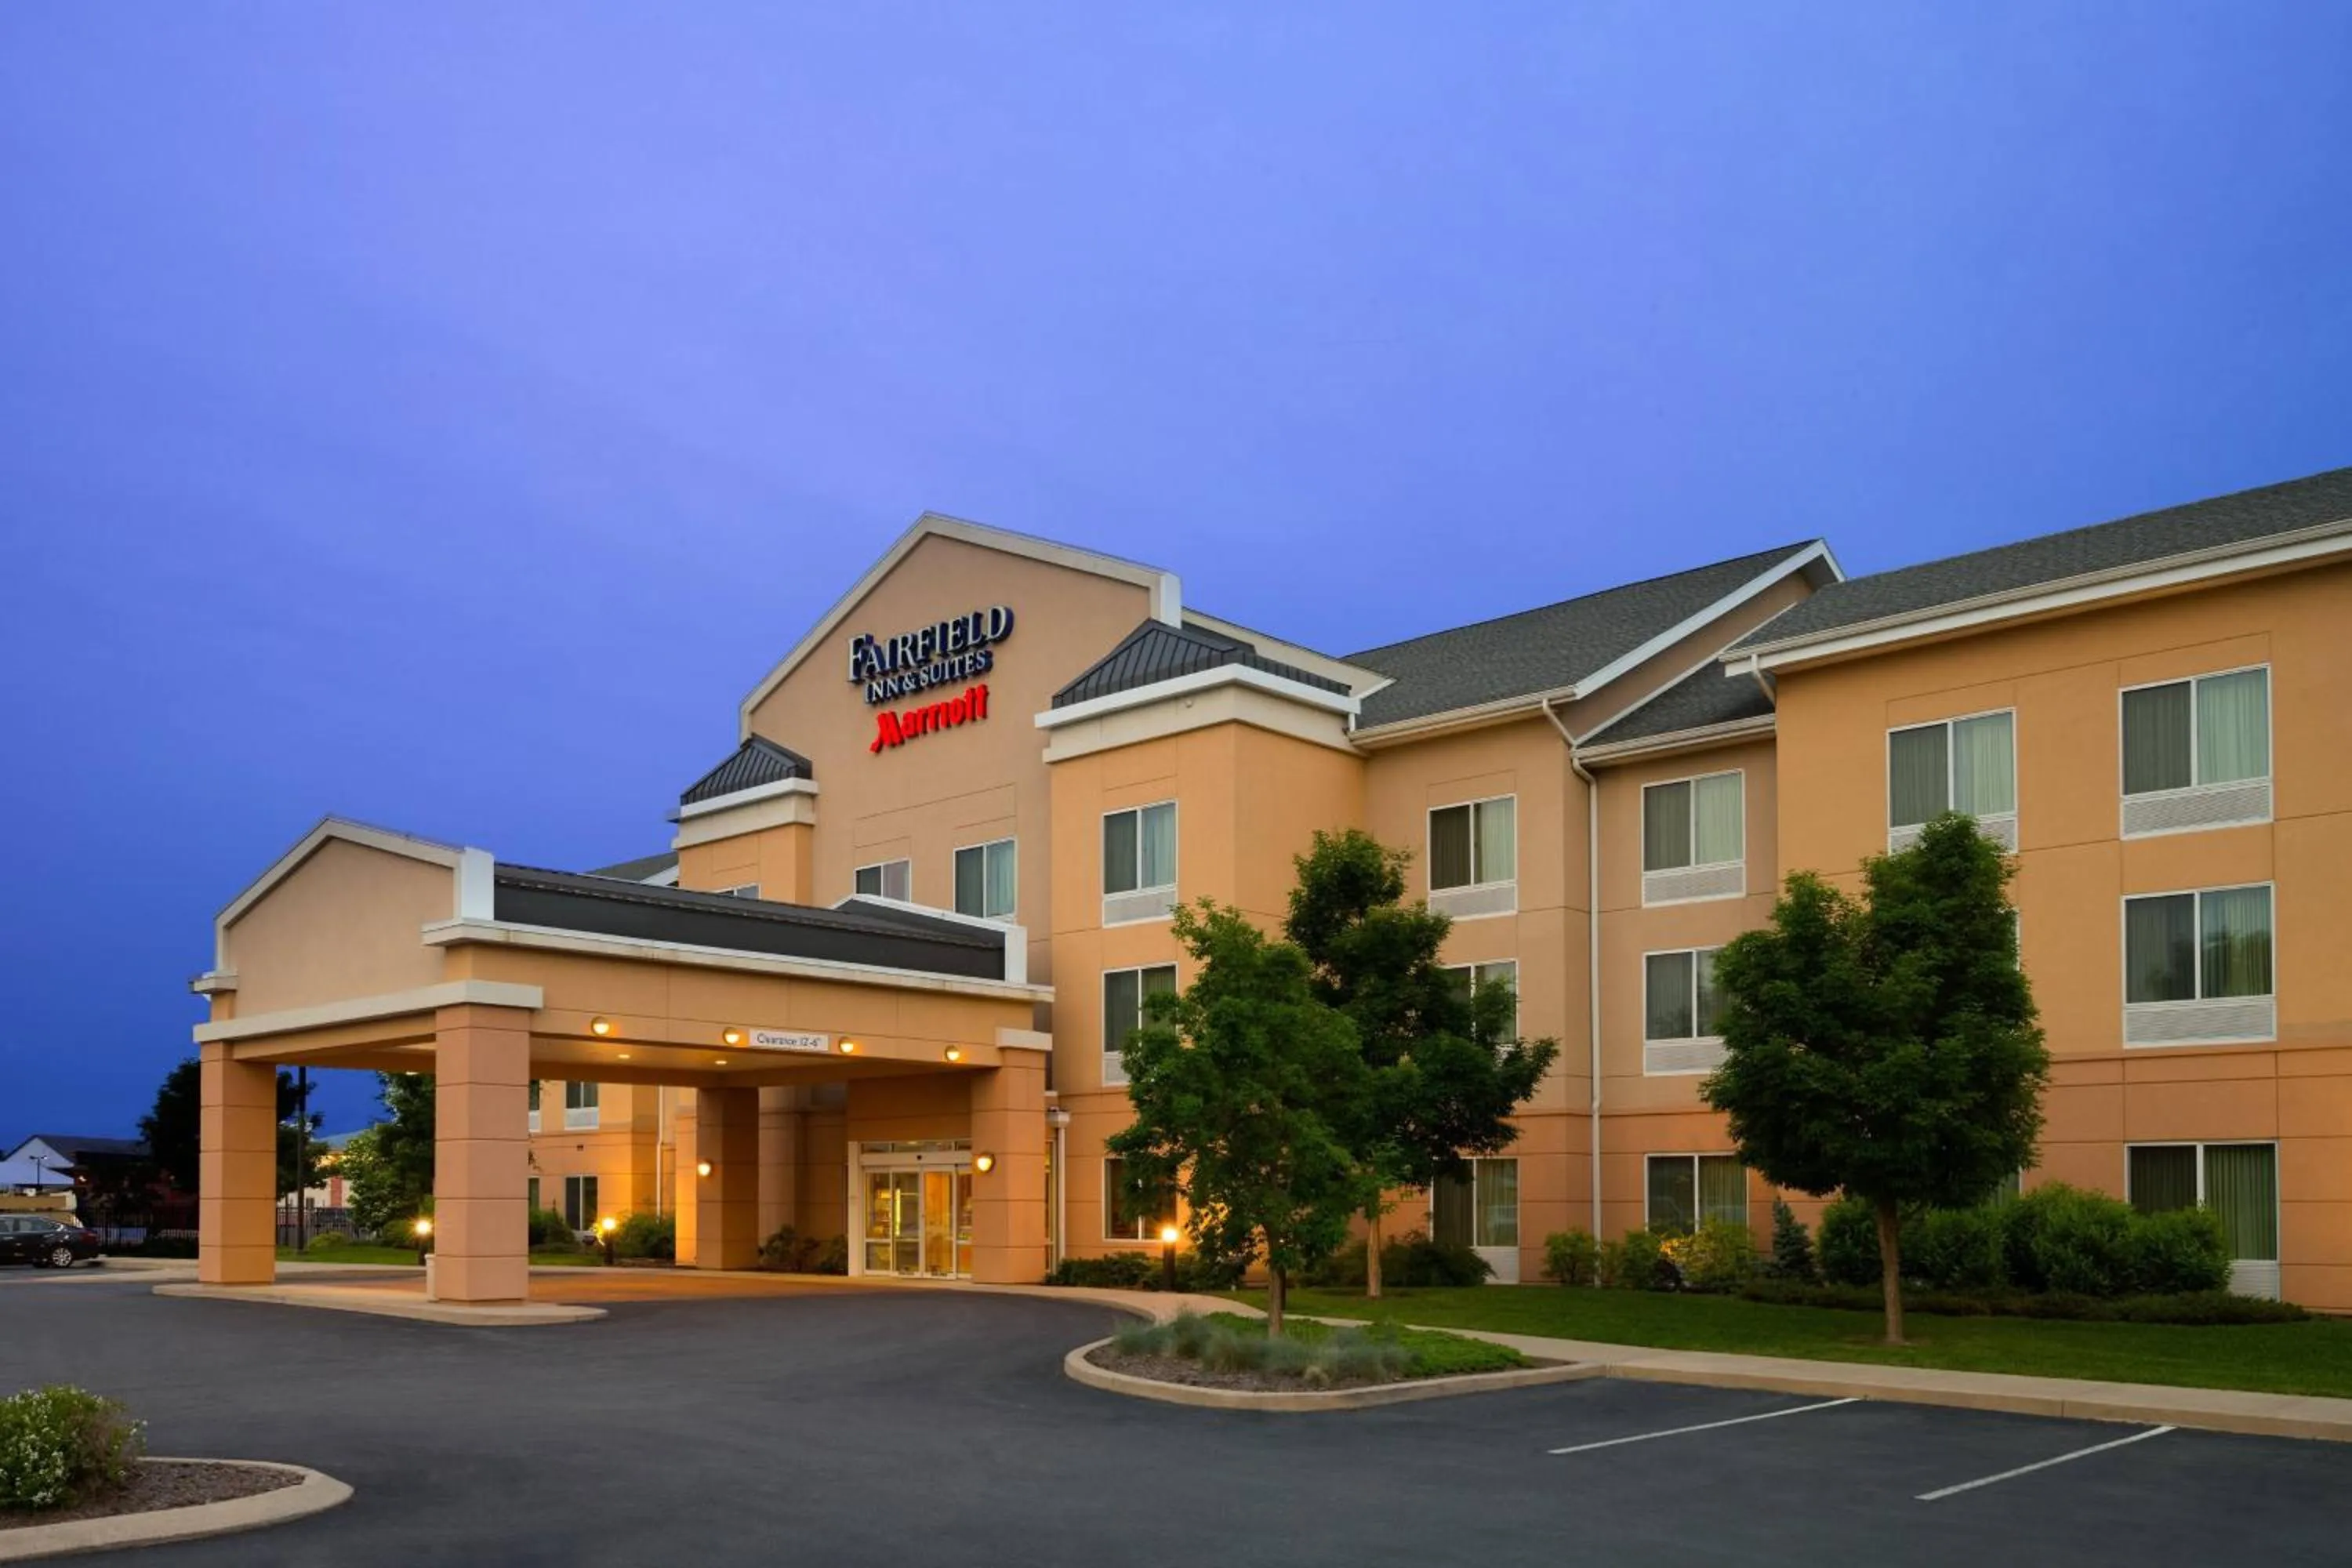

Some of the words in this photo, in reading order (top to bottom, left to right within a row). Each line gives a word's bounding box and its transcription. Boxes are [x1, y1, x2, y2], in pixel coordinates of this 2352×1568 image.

[848, 605, 1014, 684] FAIRFIELD
[865, 677, 901, 706] INN
[902, 670, 919, 695] &
[920, 649, 993, 689] SUITES
[869, 683, 989, 754] Marriott
